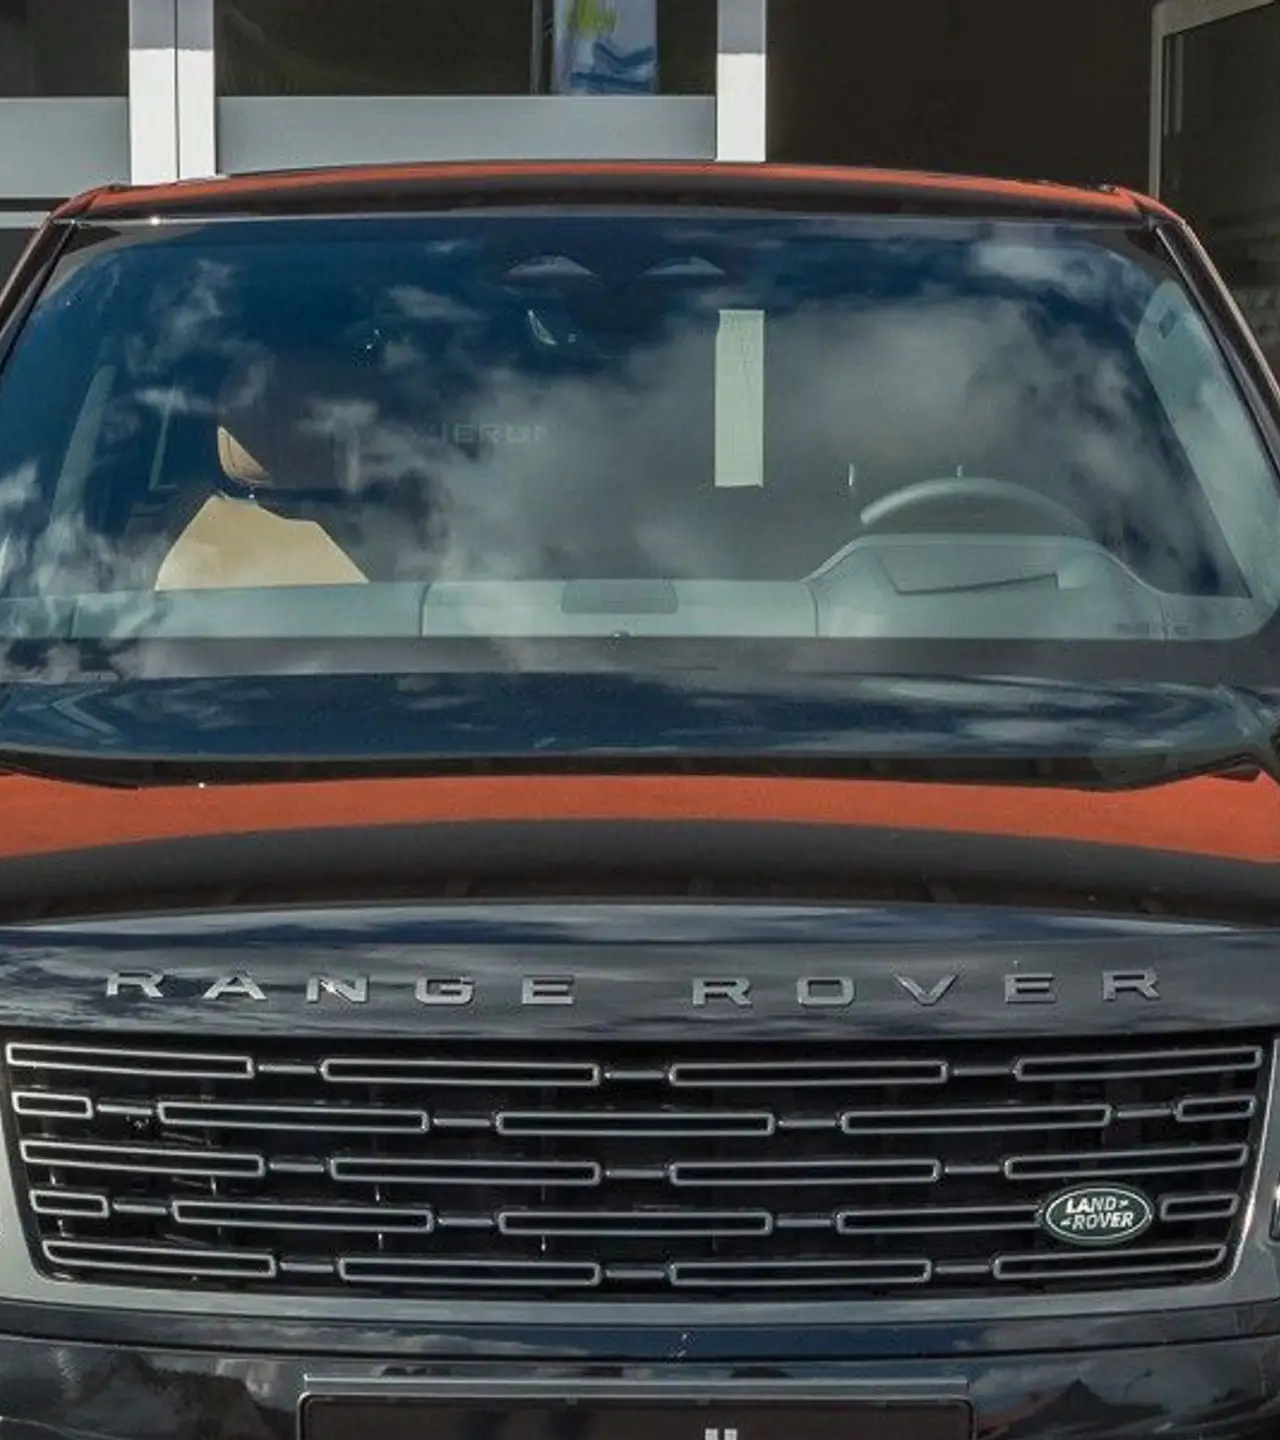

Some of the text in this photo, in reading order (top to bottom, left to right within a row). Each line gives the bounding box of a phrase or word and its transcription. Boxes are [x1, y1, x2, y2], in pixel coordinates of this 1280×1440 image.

[105, 968, 1161, 1006] RANGE ROVER
[1065, 1196, 1117, 1214] LAND
[1071, 1211, 1134, 1230] ROVER
